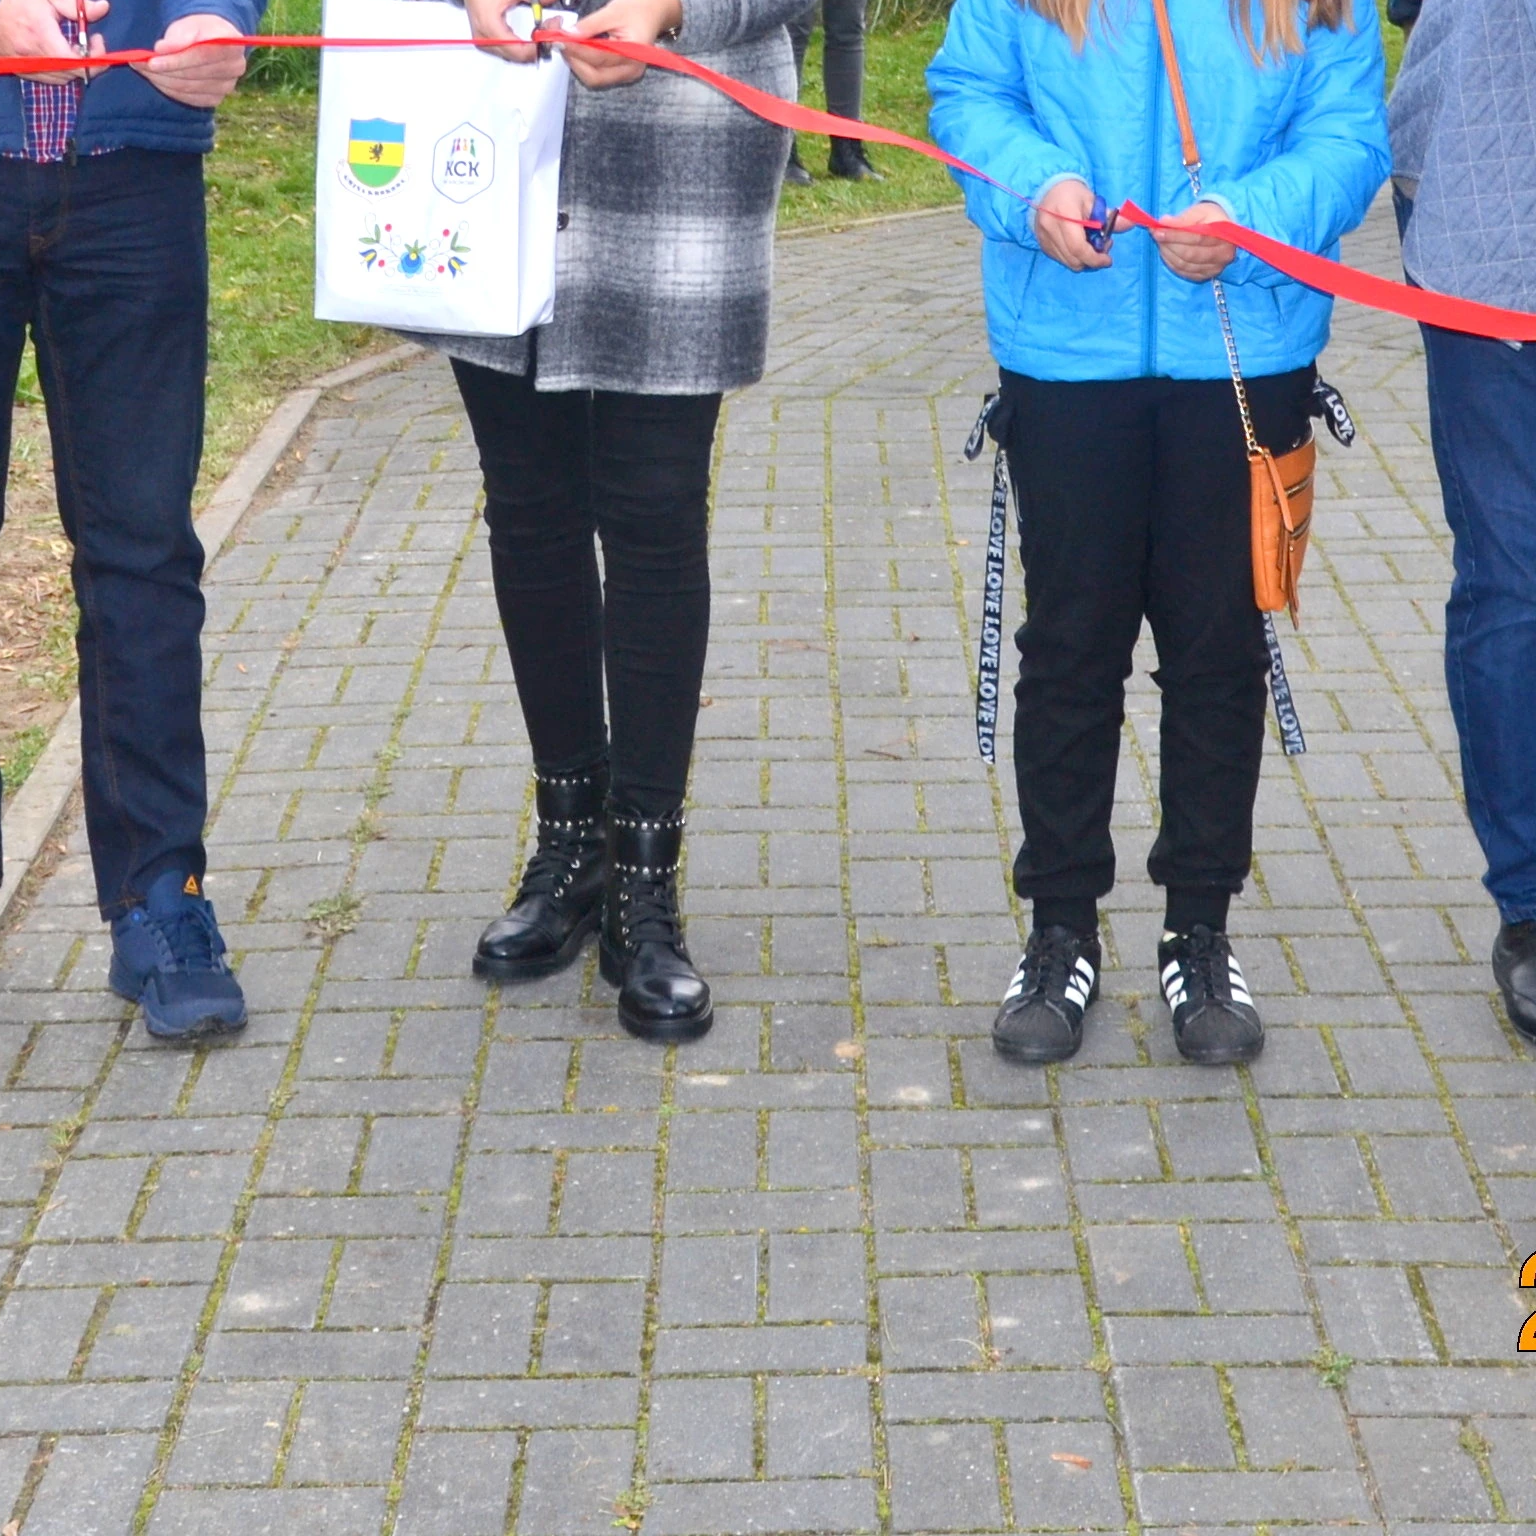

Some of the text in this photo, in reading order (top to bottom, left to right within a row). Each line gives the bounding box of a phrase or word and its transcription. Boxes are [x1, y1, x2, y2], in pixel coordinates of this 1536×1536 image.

[445, 161, 480, 177] KCK
[987, 507, 1006, 560] LOVE
[985, 562, 1004, 614] LOVE
[981, 615, 1000, 668] LOVE
[977, 671, 997, 723] LOVE
[1270, 647, 1289, 700] LOVE
[1278, 703, 1304, 756] LOVE
